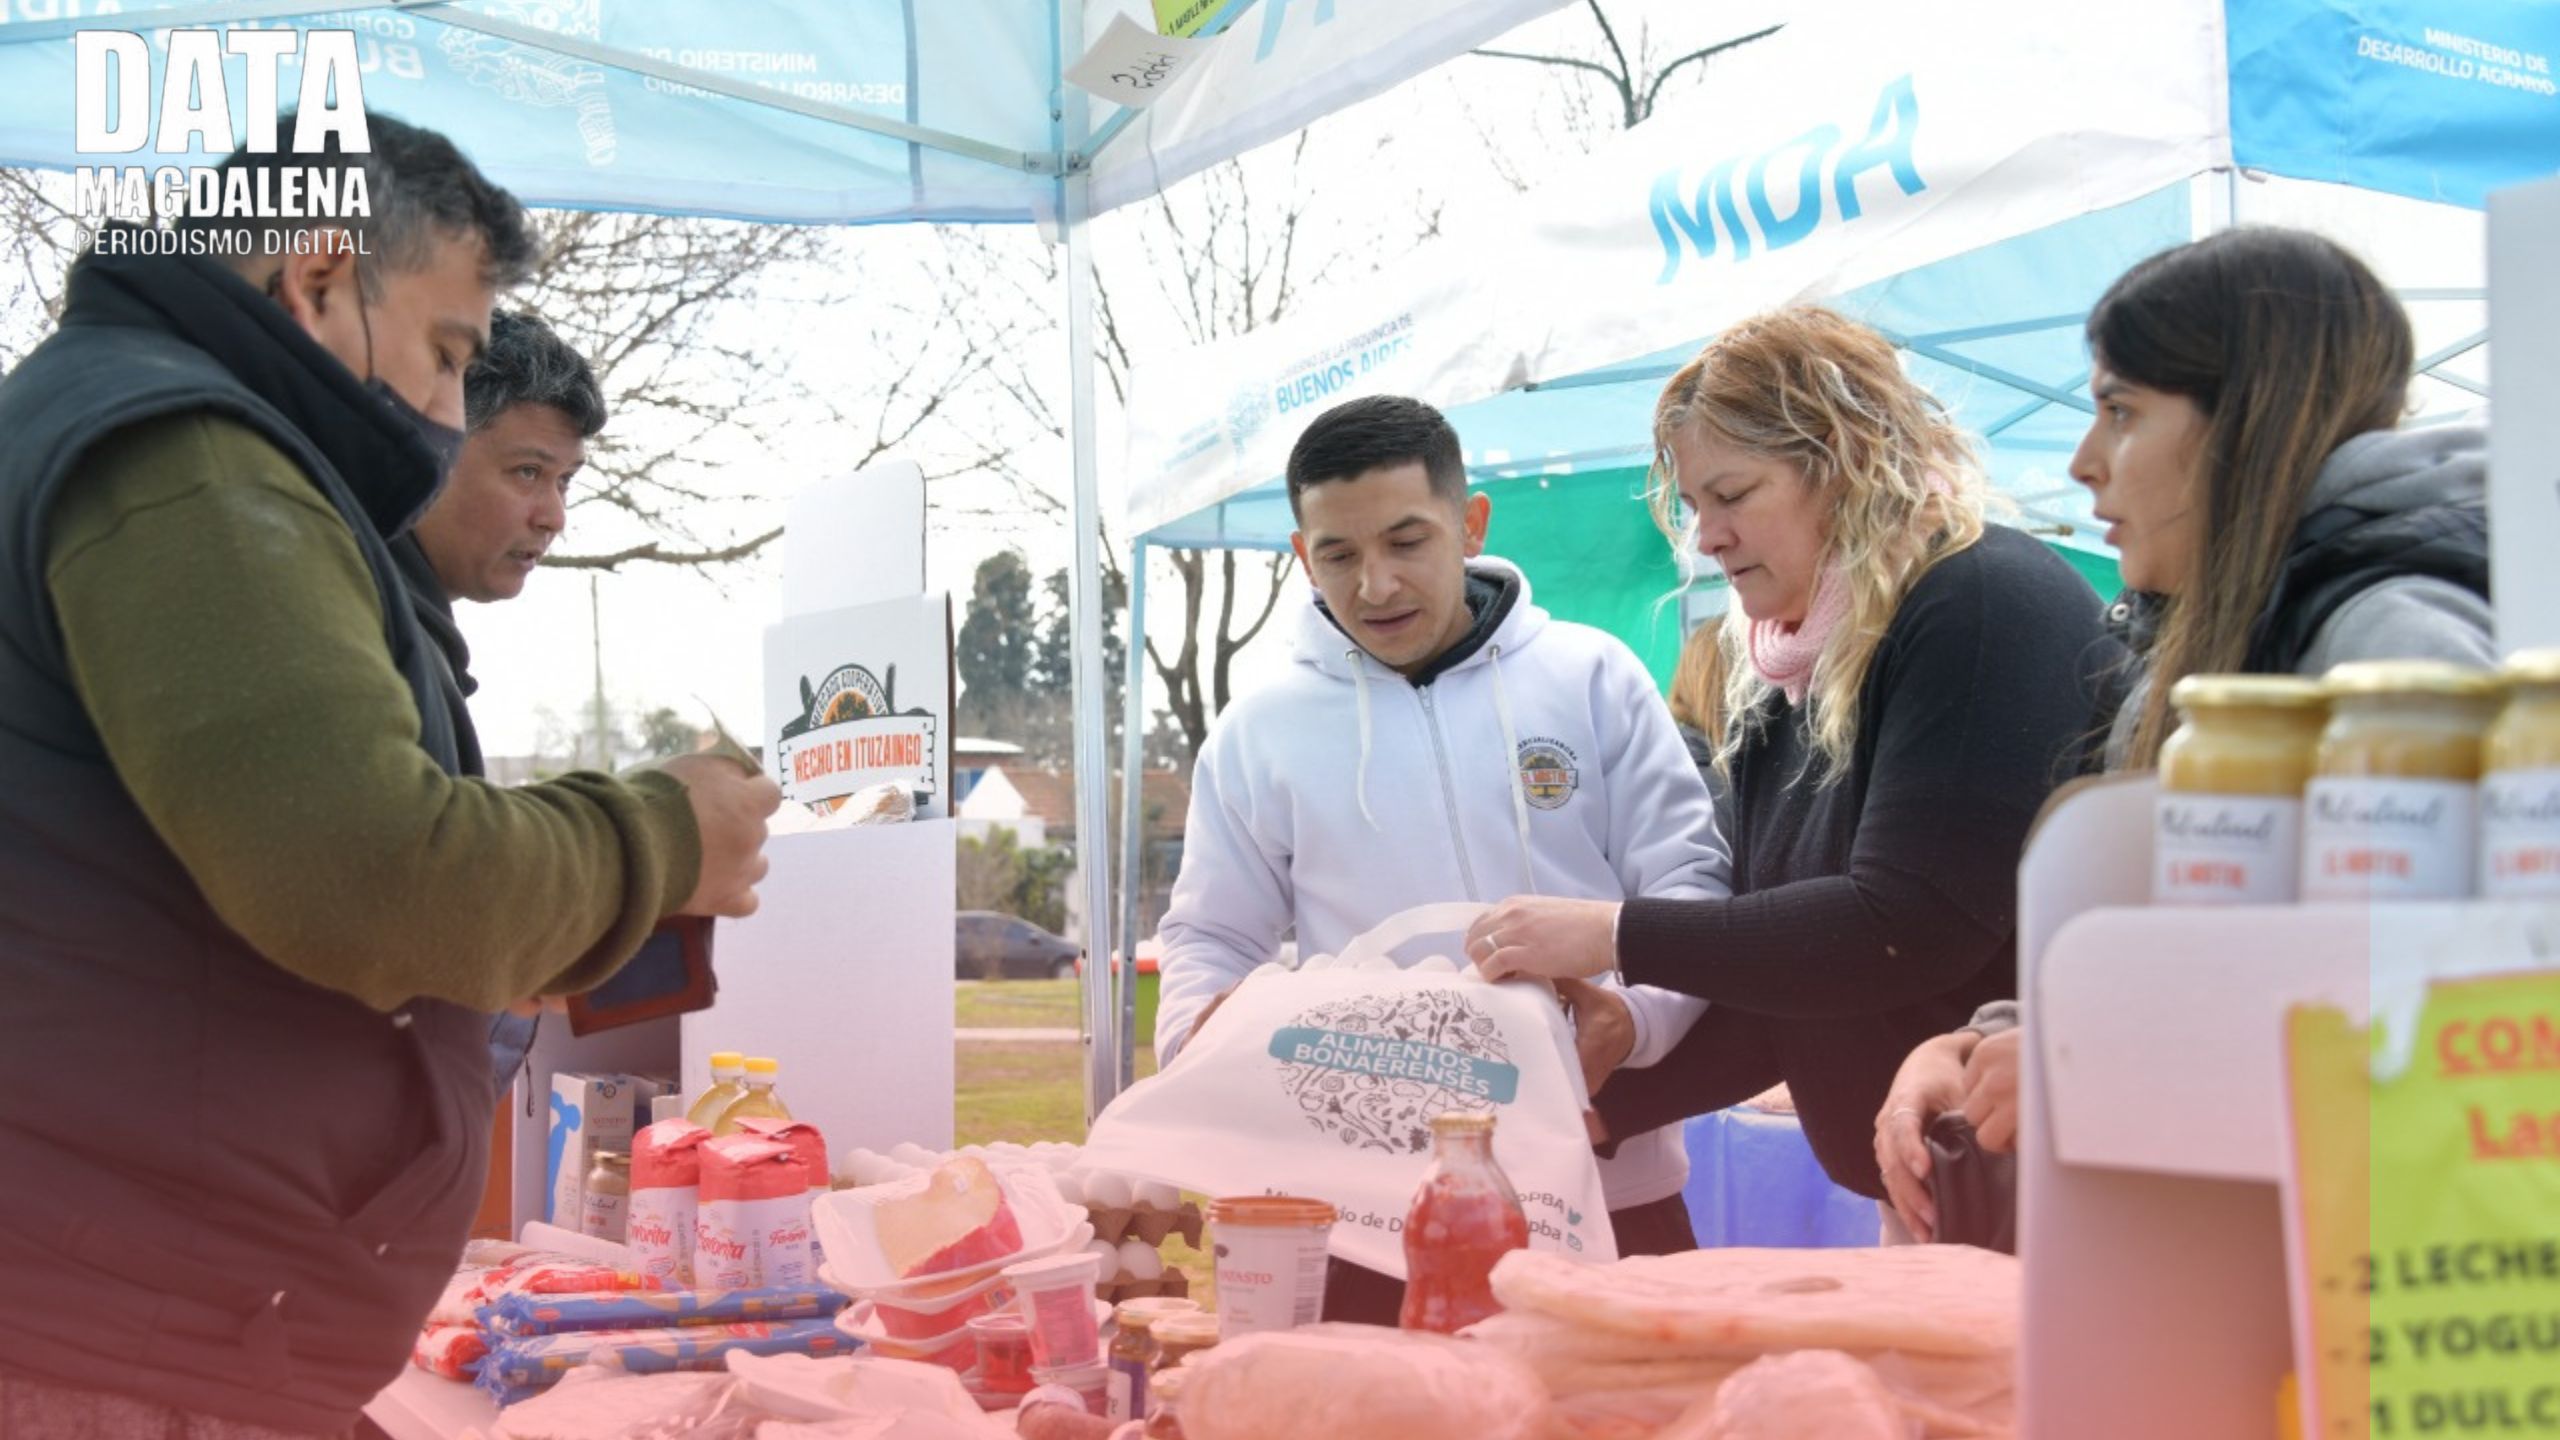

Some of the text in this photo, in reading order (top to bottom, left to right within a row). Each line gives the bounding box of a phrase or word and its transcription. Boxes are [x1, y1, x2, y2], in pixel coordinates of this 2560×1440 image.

[2356, 35, 2556, 96] DESARROLLO AGRARIO
[2423, 27, 2549, 73] MINISTERIO DE
[1649, 72, 1927, 286] MDA
[1276, 358, 1354, 414] BUENOS
[793, 743, 833, 784] HECHO
[836, 740, 852, 771] EN
[1293, 1042, 1491, 1096] BONAERENSES
[1317, 1032, 1473, 1074] ALIMENTOS
[1360, 1210, 1384, 1230] de
